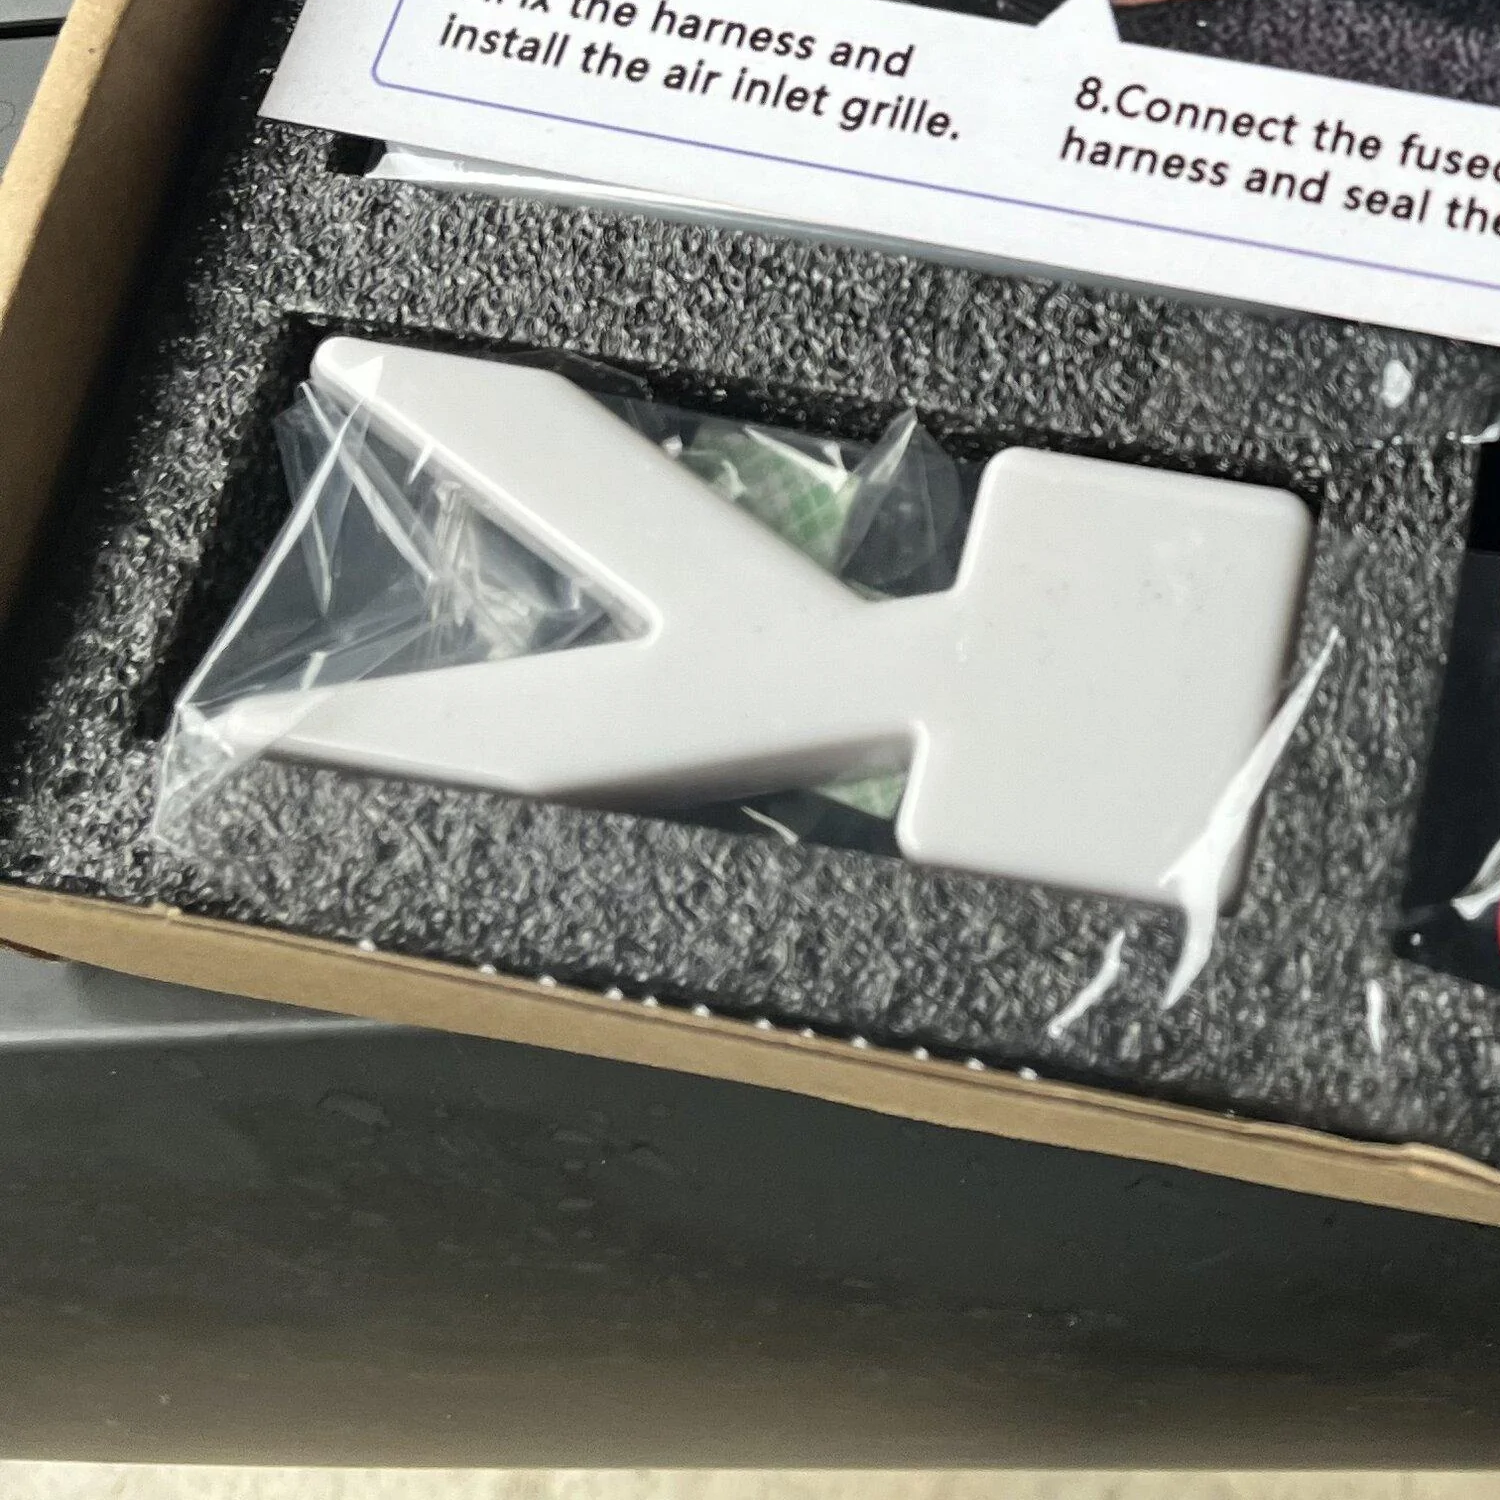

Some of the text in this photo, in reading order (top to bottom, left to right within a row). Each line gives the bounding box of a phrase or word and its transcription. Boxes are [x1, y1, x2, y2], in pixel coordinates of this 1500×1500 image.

[439, 12, 959, 141] install the air inlet grille.
[829, 41, 915, 78] and
[1075, 75, 1299, 147] 8.Connect
[1313, 119, 1383, 161] the
[1060, 125, 1229, 188] harness
[1244, 167, 1330, 205] and
[1343, 185, 1431, 223] seal
